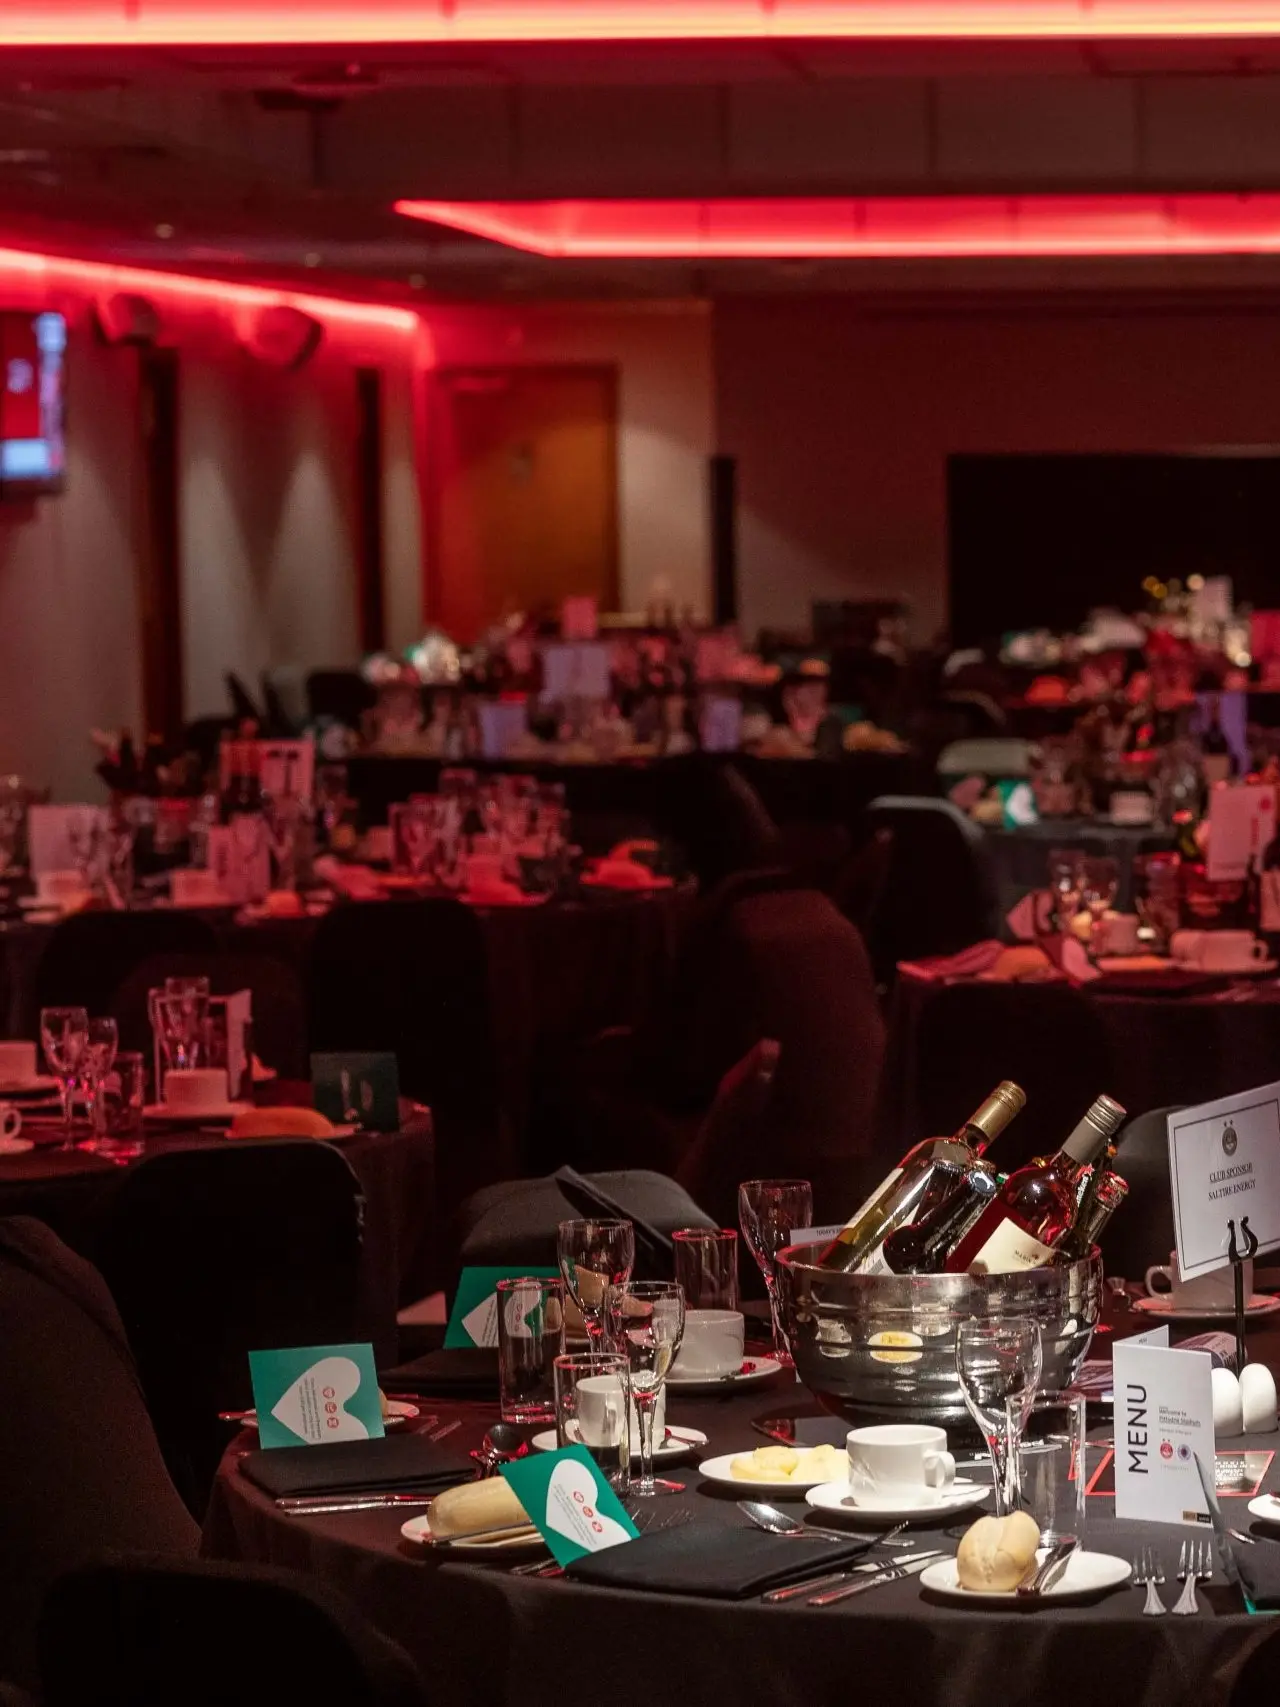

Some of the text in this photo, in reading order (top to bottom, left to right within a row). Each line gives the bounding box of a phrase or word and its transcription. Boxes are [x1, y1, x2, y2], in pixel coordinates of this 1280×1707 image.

[1209, 1170, 1226, 1183] CLUB
[1208, 1179, 1256, 1200] SALTIRE ENERGY
[1126, 1384, 1149, 1474] MENU
